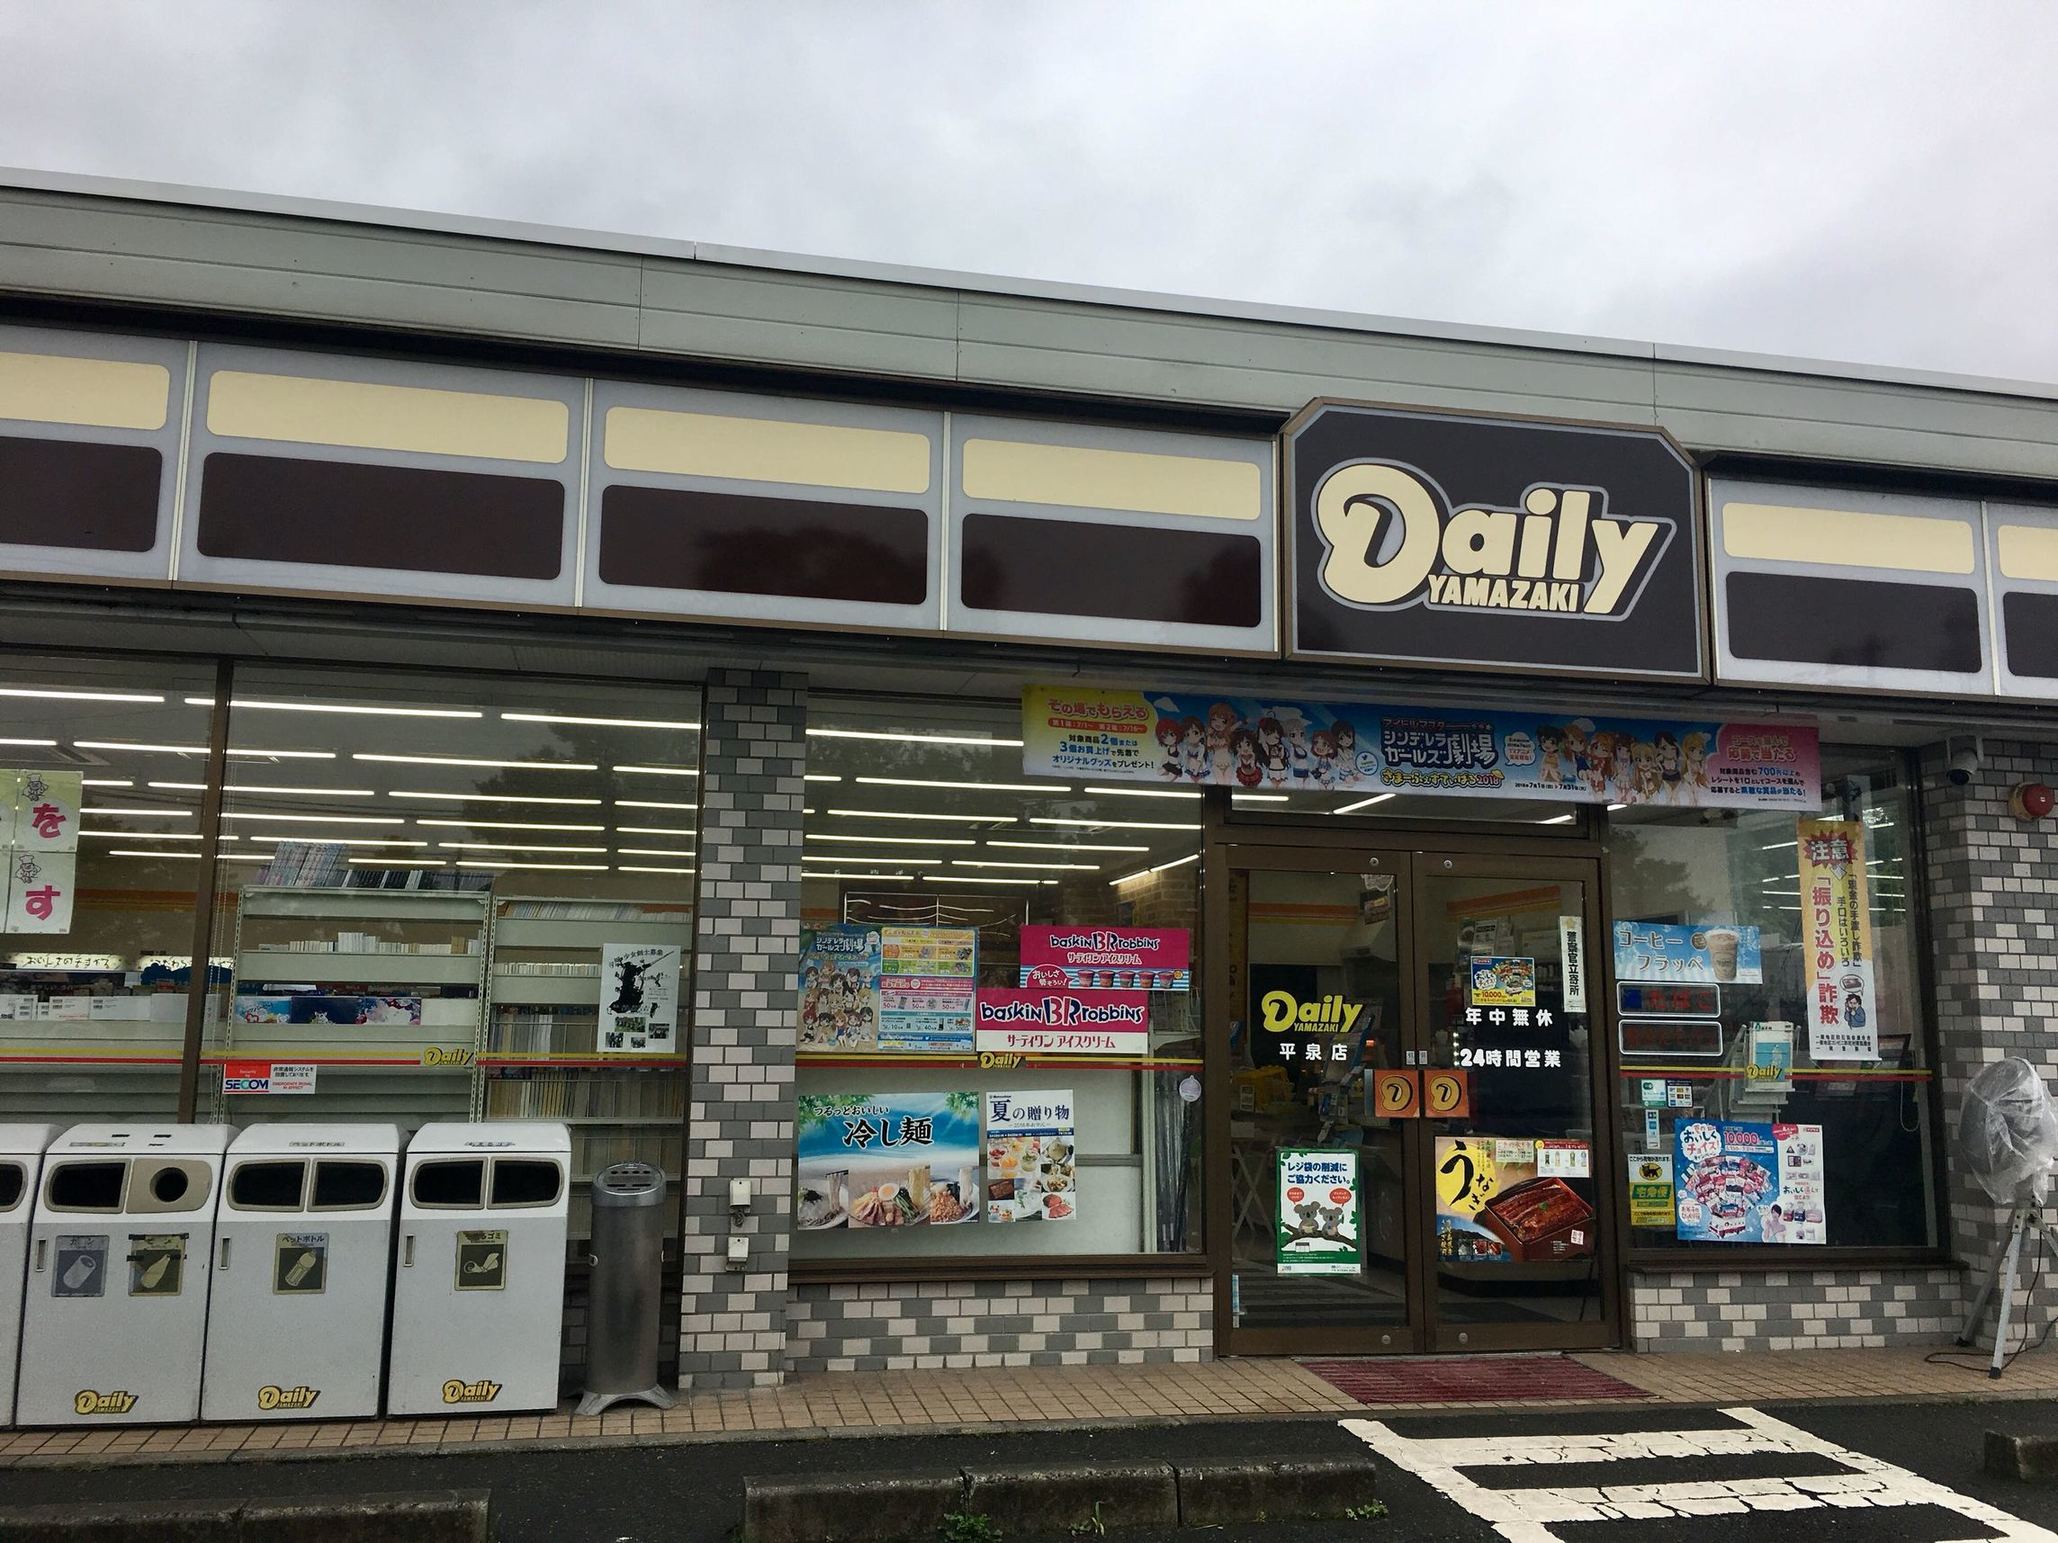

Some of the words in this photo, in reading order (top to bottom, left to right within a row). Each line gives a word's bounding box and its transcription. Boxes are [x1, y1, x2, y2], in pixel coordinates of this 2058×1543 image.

[1318, 464, 1658, 613] Daily
[1427, 574, 1579, 612] YAMAZAKI
[1048, 699, 1149, 720] その場でもらえる
[1060, 741, 1140, 757] 3個お買上げで先着で
[1069, 733, 1138, 746] 対象商品2個または
[1383, 730, 1447, 749] シンデレラ
[1385, 747, 1460, 765] ガールズ
[1446, 733, 1498, 766] 劇場
[32, 803, 67, 838] を
[1811, 839, 1849, 861] 注意
[25, 885, 61, 921] す
[1050, 936, 1092, 949] baskin
[1118, 937, 1160, 950] robbins
[1619, 930, 1683, 949] コーヒー
[1067, 952, 1100, 964] サーティワン
[1101, 953, 1142, 965] アイスクリーム
[1812, 875, 1840, 1026] 「振り込め」詐欺
[1566, 930, 1580, 997] 警察官立寄所
[1637, 954, 1704, 972] フラッペ
[980, 1001, 1042, 1023] baskin
[1081, 1004, 1145, 1024] robbins
[1262, 990, 1363, 1033] Daily
[1465, 1007, 1553, 1027] 年中無休
[1293, 1022, 1339, 1033] YAMAZAKI
[1007, 1034, 1053, 1048] サーティワン
[1057, 1035, 1116, 1049] アイスクリーム
[424, 1047, 474, 1065] Daily
[980, 1051, 1021, 1069] Daily
[1279, 1042, 1348, 1061] 平泉店
[1460, 1048, 1561, 1068] 24時間営業
[1747, 1064, 1782, 1081] Daily
[225, 1079, 269, 1090] SECOM
[814, 1104, 889, 1117] つるっとおいしい
[990, 1099, 1070, 1122] 夏の贈り物
[843, 1116, 933, 1149] 冷し麺
[1287, 1162, 1348, 1173] レジ袋の削減に
[1287, 1174, 1351, 1185] ご協力ください。
[282, 1235, 325, 1243] ペットボトル
[258, 1386, 321, 1410] Daily
[443, 1380, 501, 1403] Daily
[75, 1389, 138, 1415] Daily
